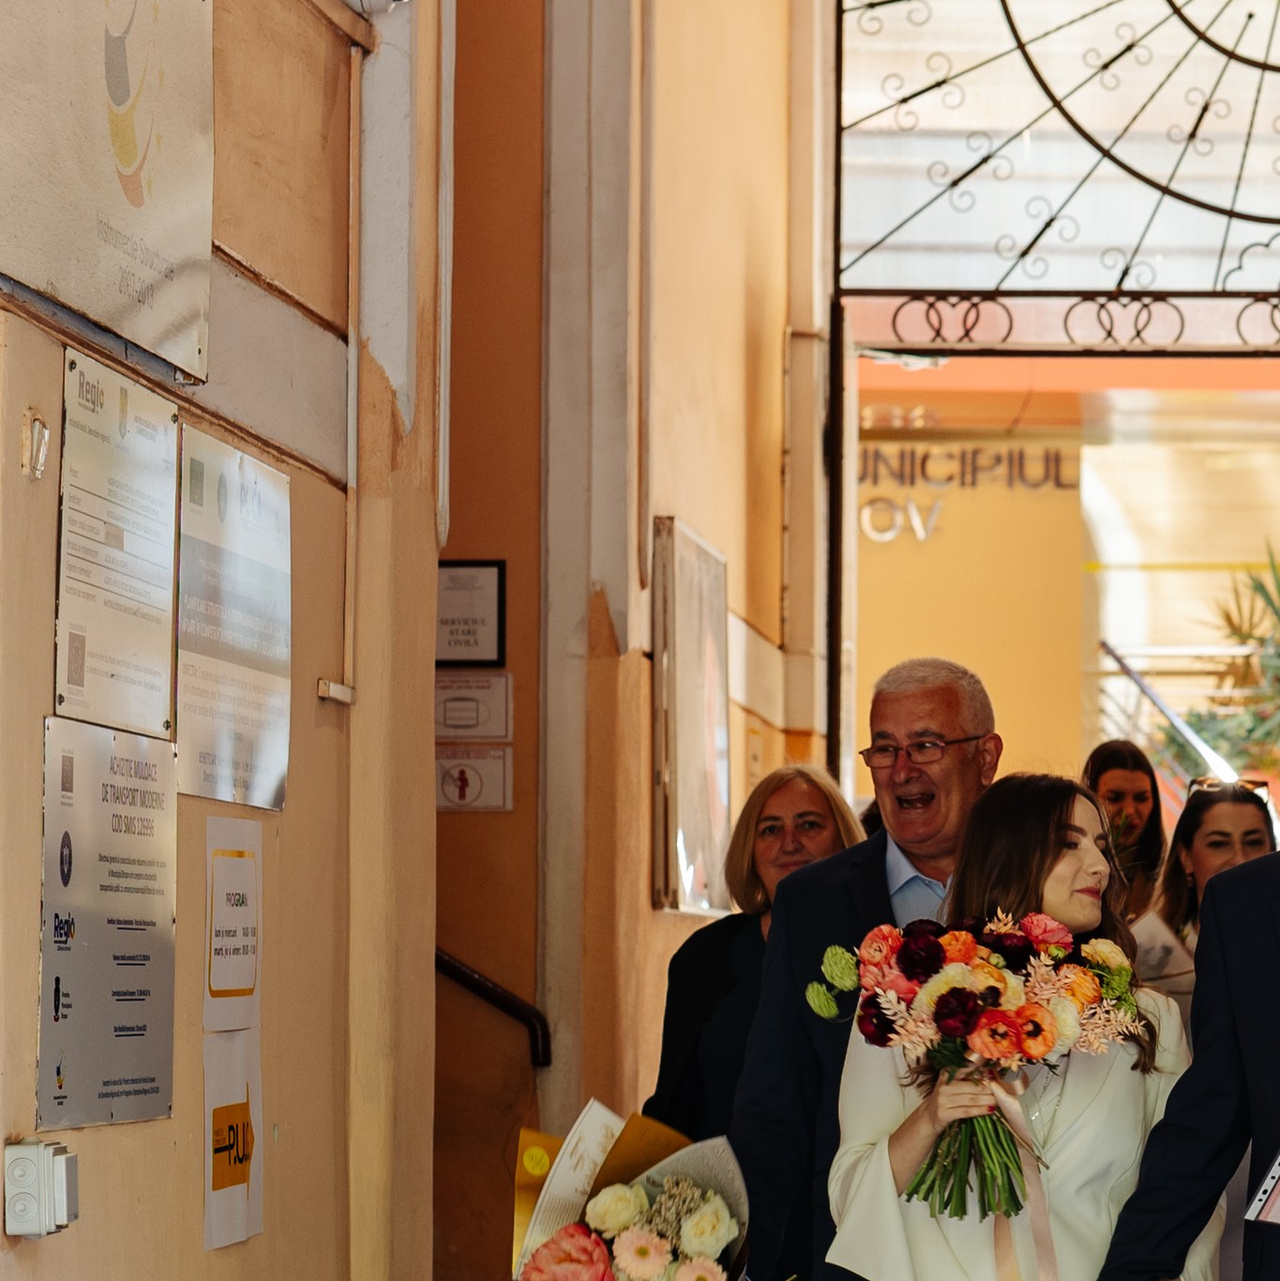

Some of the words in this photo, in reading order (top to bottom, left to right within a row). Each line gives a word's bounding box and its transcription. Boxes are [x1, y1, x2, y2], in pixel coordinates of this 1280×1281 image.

[78, 370, 105, 413] Regio
[860, 496, 943, 543] OV
[102, 782, 108, 803] DE
[110, 783, 139, 808] TRANSPORT
[139, 789, 164, 811] MODERNE
[112, 813, 122, 833] COD
[53, 912, 75, 944] Regio
